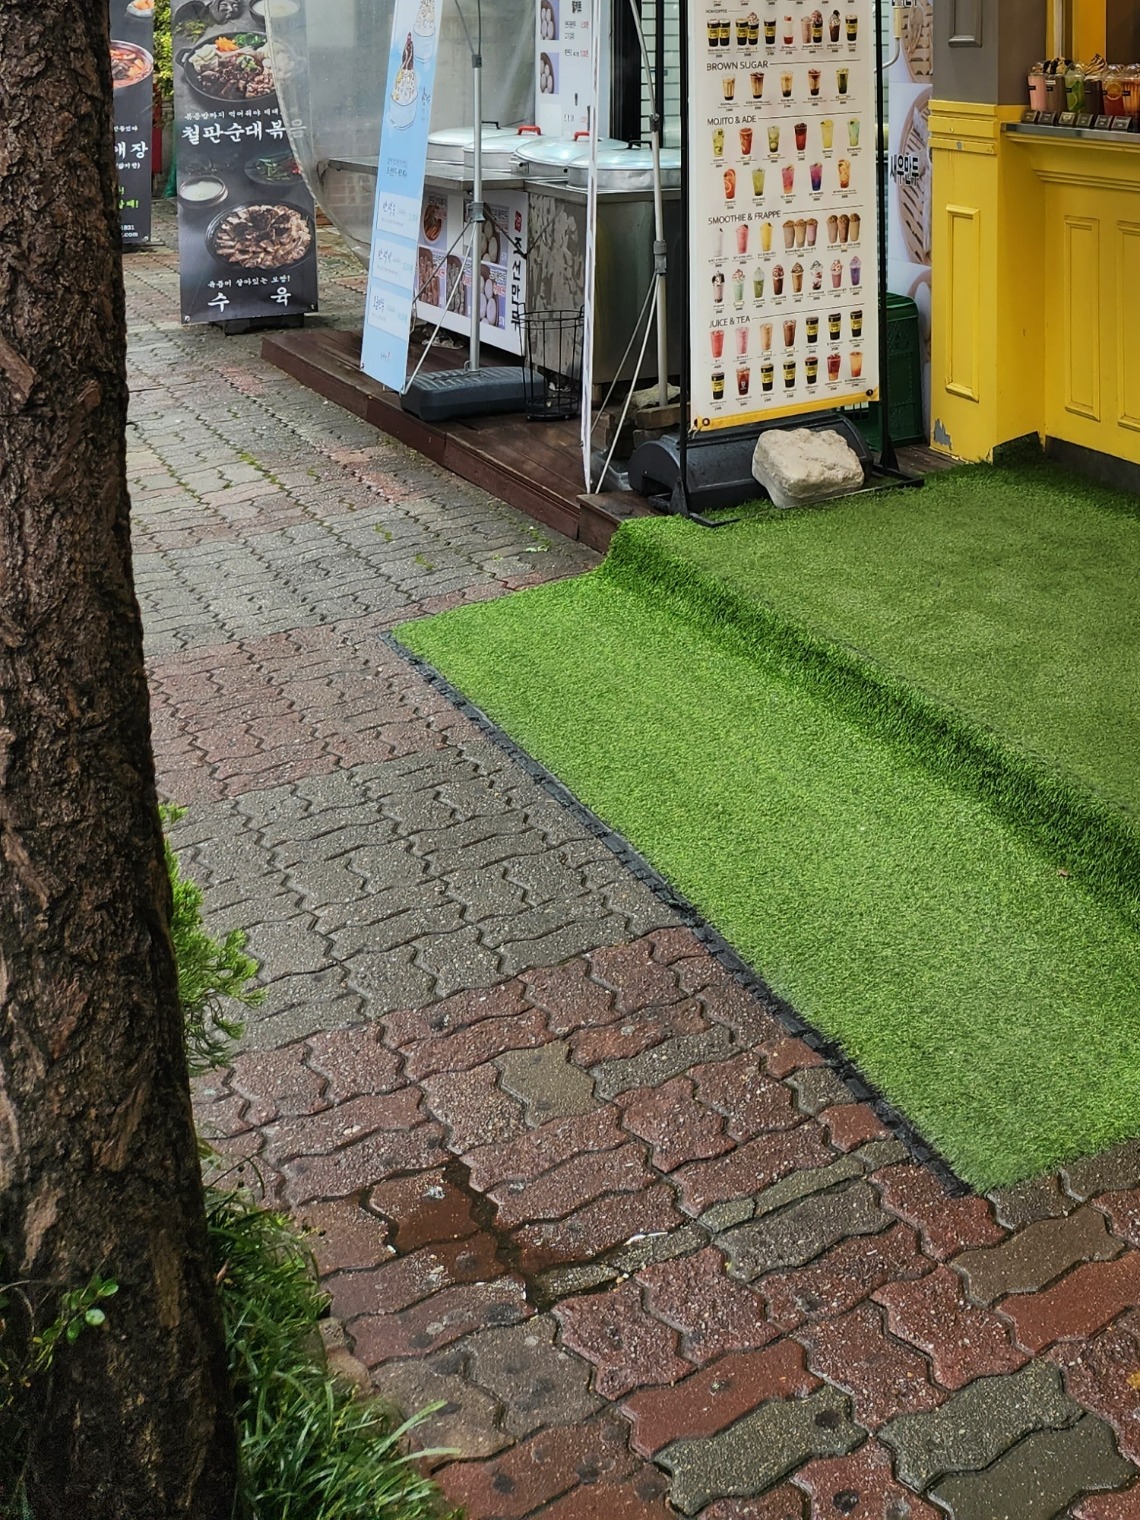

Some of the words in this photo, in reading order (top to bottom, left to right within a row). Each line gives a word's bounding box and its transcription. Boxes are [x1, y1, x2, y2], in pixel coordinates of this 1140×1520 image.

[706, 62, 738, 72] BROWN
[739, 60, 769, 70] SUGAR
[706, 116, 734, 126] MOJITO
[741, 114, 757, 124] ADE
[708, 213, 747, 226] SMOOTHIE
[754, 209, 781, 221] FRAPPE
[709, 318, 728, 329] JUICE
[736, 315, 751, 325] TEA
